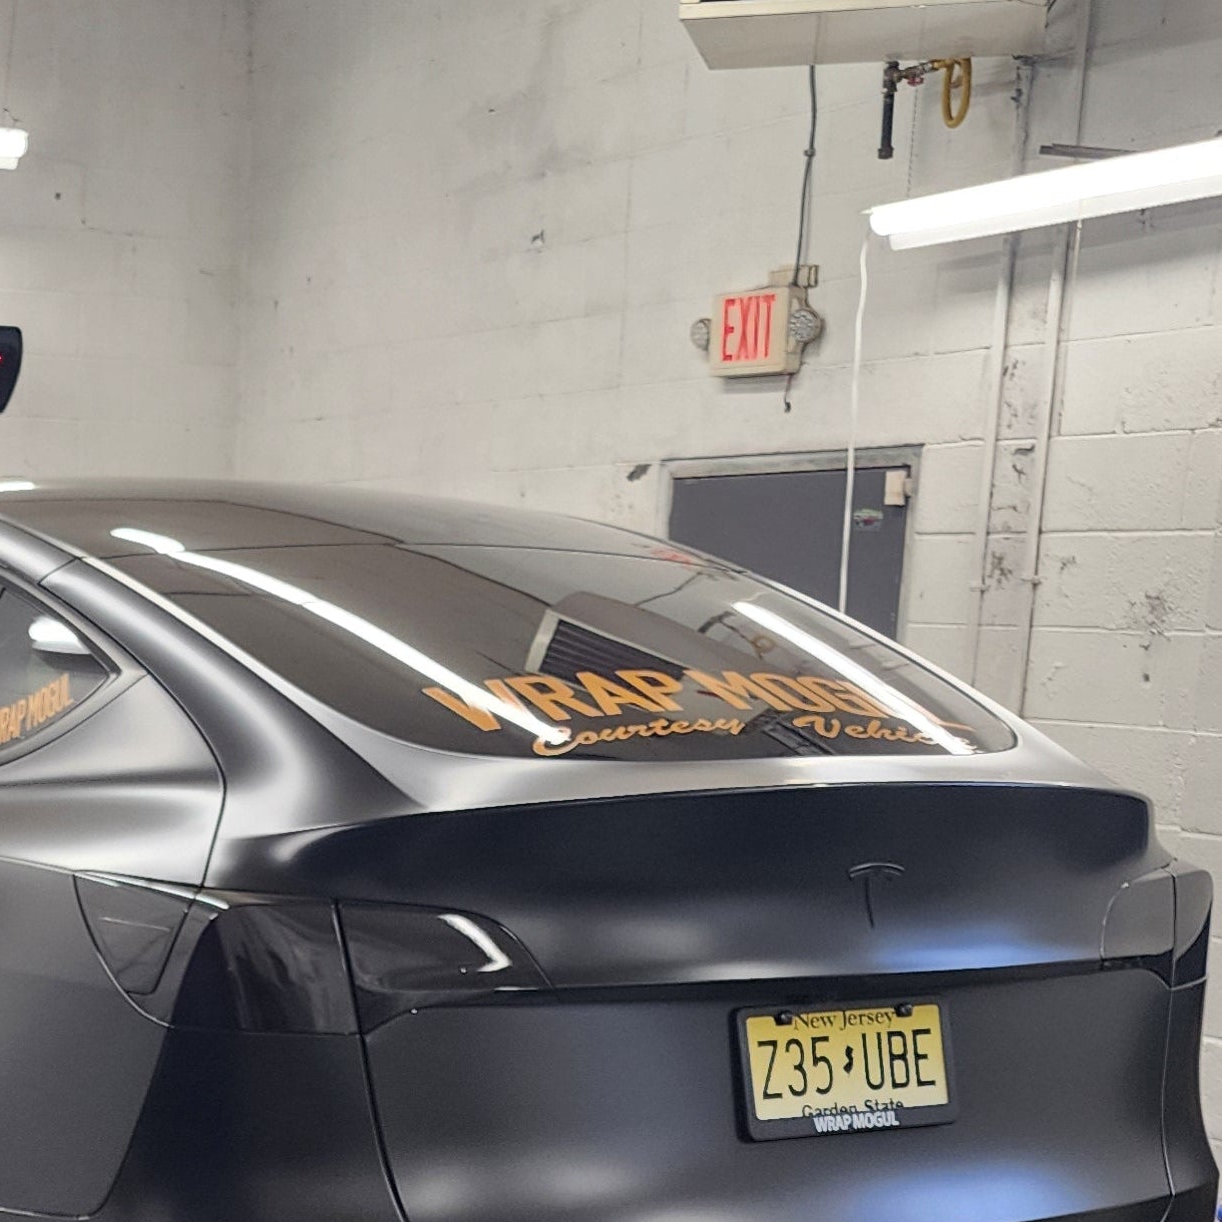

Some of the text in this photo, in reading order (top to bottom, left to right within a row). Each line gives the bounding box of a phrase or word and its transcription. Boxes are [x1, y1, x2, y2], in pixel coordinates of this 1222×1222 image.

[721, 294, 776, 362] EXIT
[422, 669, 684, 732] WRAP
[532, 714, 982, 757] Courtesy Vehic
[793, 1010, 896, 1032] New Jersey
[757, 1028, 937, 1100] Z35 UBE
[801, 1098, 904, 1118] Garden State
[813, 1110, 900, 1133] WRAP MOGUL
